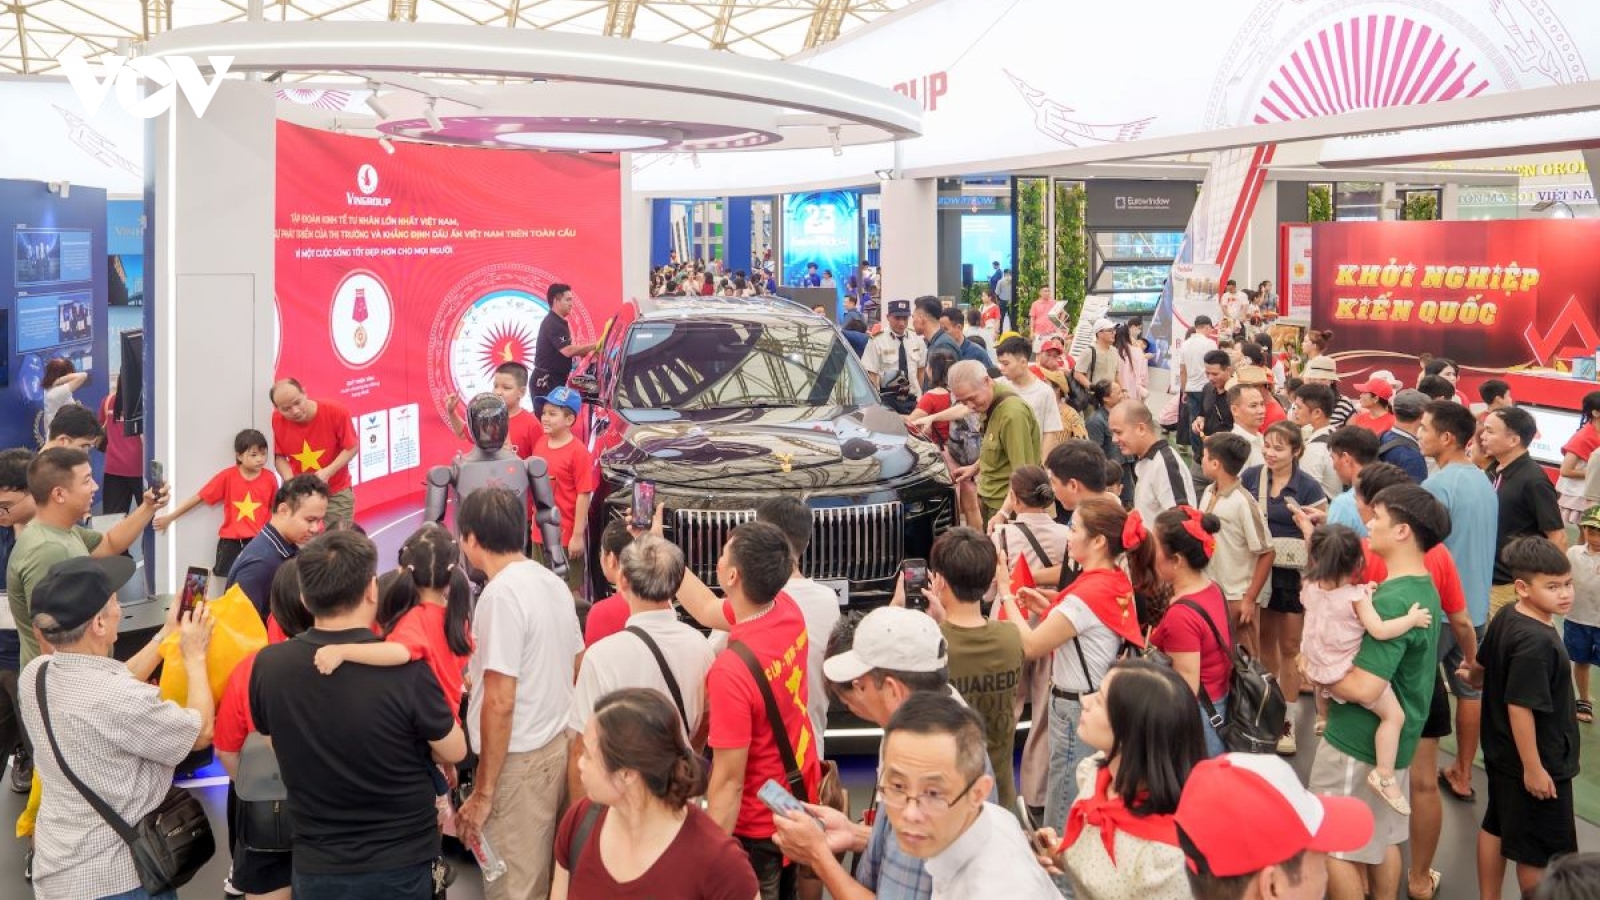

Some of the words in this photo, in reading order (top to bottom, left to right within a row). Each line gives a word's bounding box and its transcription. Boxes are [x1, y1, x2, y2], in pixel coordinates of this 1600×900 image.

[1573, 188, 1595, 200] NA
[464, 228, 482, 240] VIỆT
[484, 229, 504, 238] NAM
[530, 227, 556, 238] TOÀN
[398, 247, 412, 256] CHO
[1335, 257, 1418, 288] KHỞI
[1421, 260, 1541, 297] NGHIỆP
[1335, 291, 1414, 322] KIẾN
[1418, 293, 1498, 325] QUỐC
